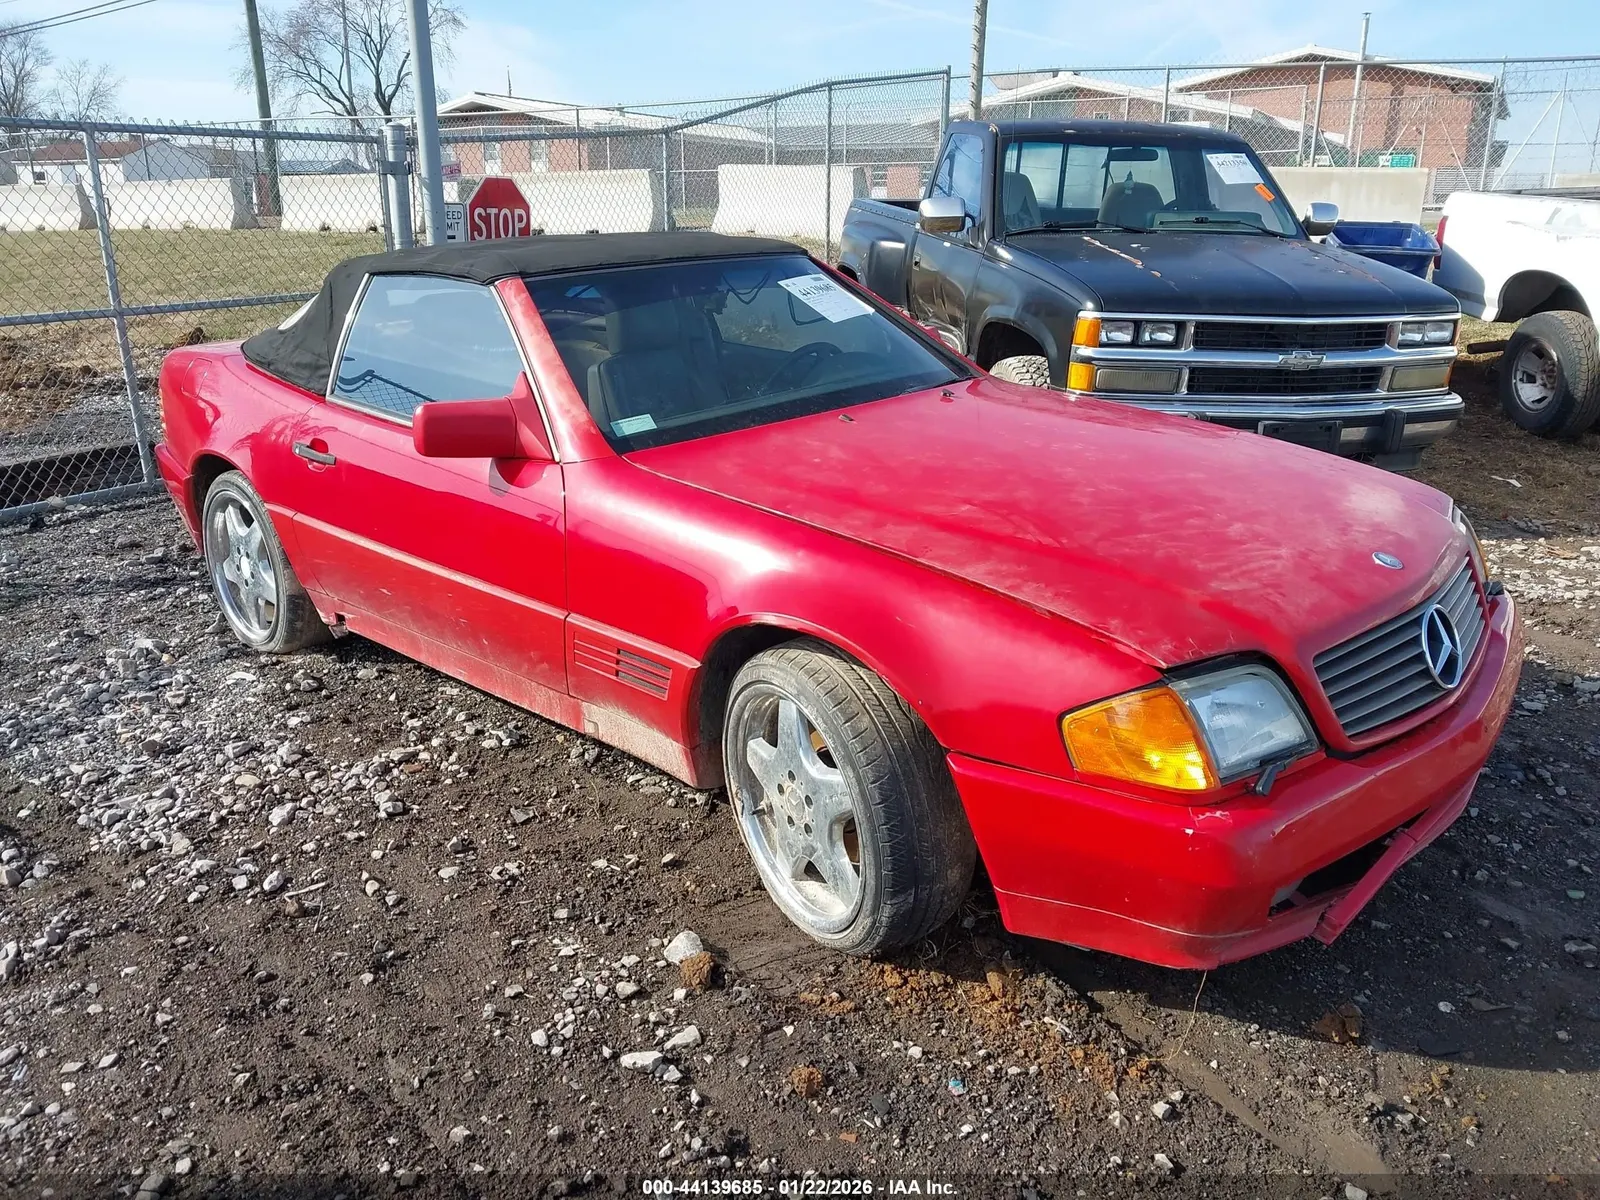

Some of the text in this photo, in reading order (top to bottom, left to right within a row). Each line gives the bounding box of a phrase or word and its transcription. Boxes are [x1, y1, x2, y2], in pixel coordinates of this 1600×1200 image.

[446, 211, 462, 219] EED
[446, 222, 460, 231] MIT
[473, 207, 527, 241] STOP
